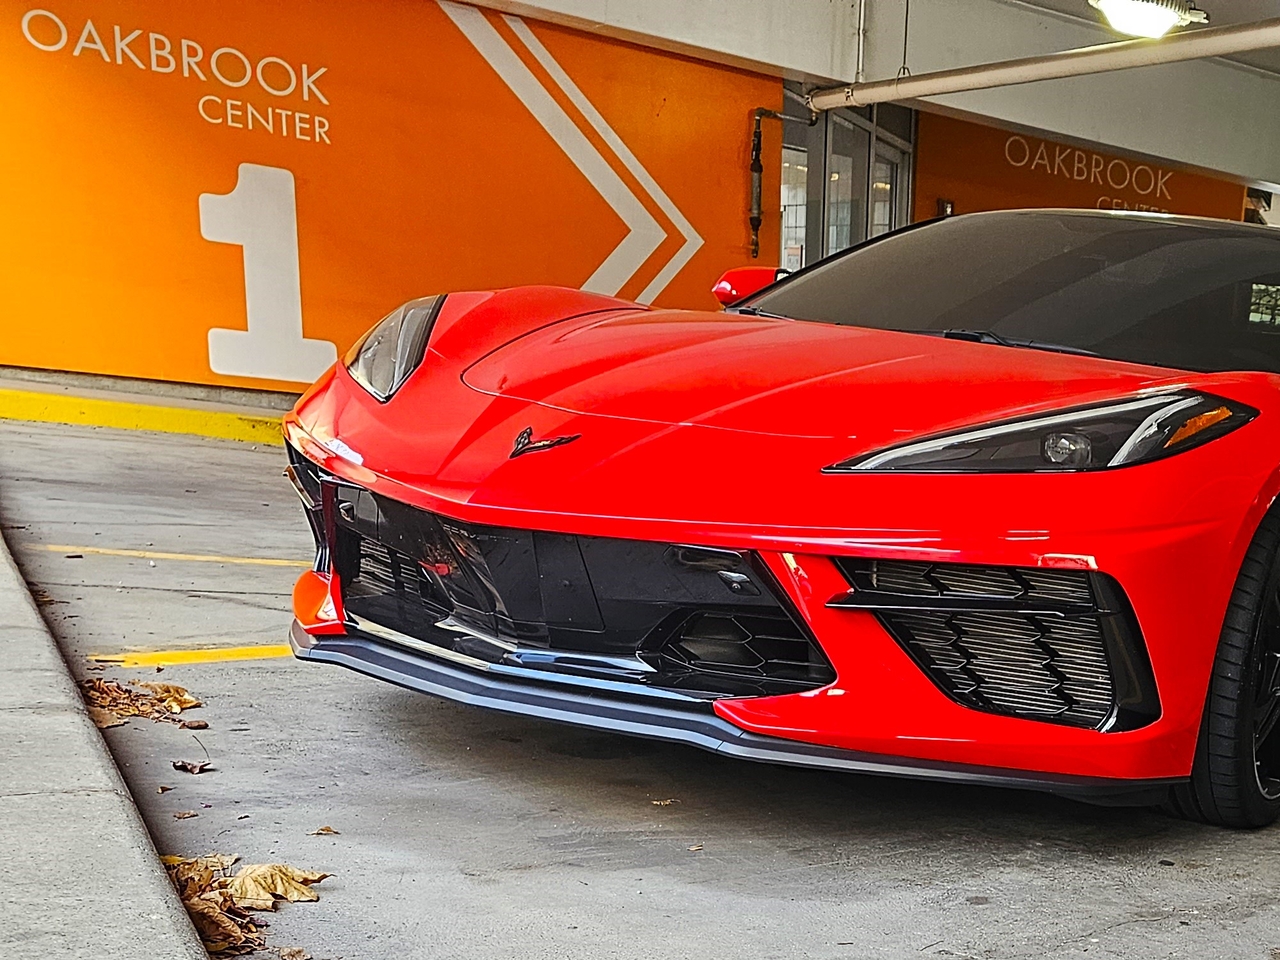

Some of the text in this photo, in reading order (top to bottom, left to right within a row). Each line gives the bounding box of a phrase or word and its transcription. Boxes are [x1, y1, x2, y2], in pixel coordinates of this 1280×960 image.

[21, 9, 330, 107] OAKBROOK
[198, 95, 332, 145] CENTER
[1004, 135, 1175, 201] OAKBROOK
[1096, 196, 1170, 214] CENT
[198, 162, 338, 383] 1
